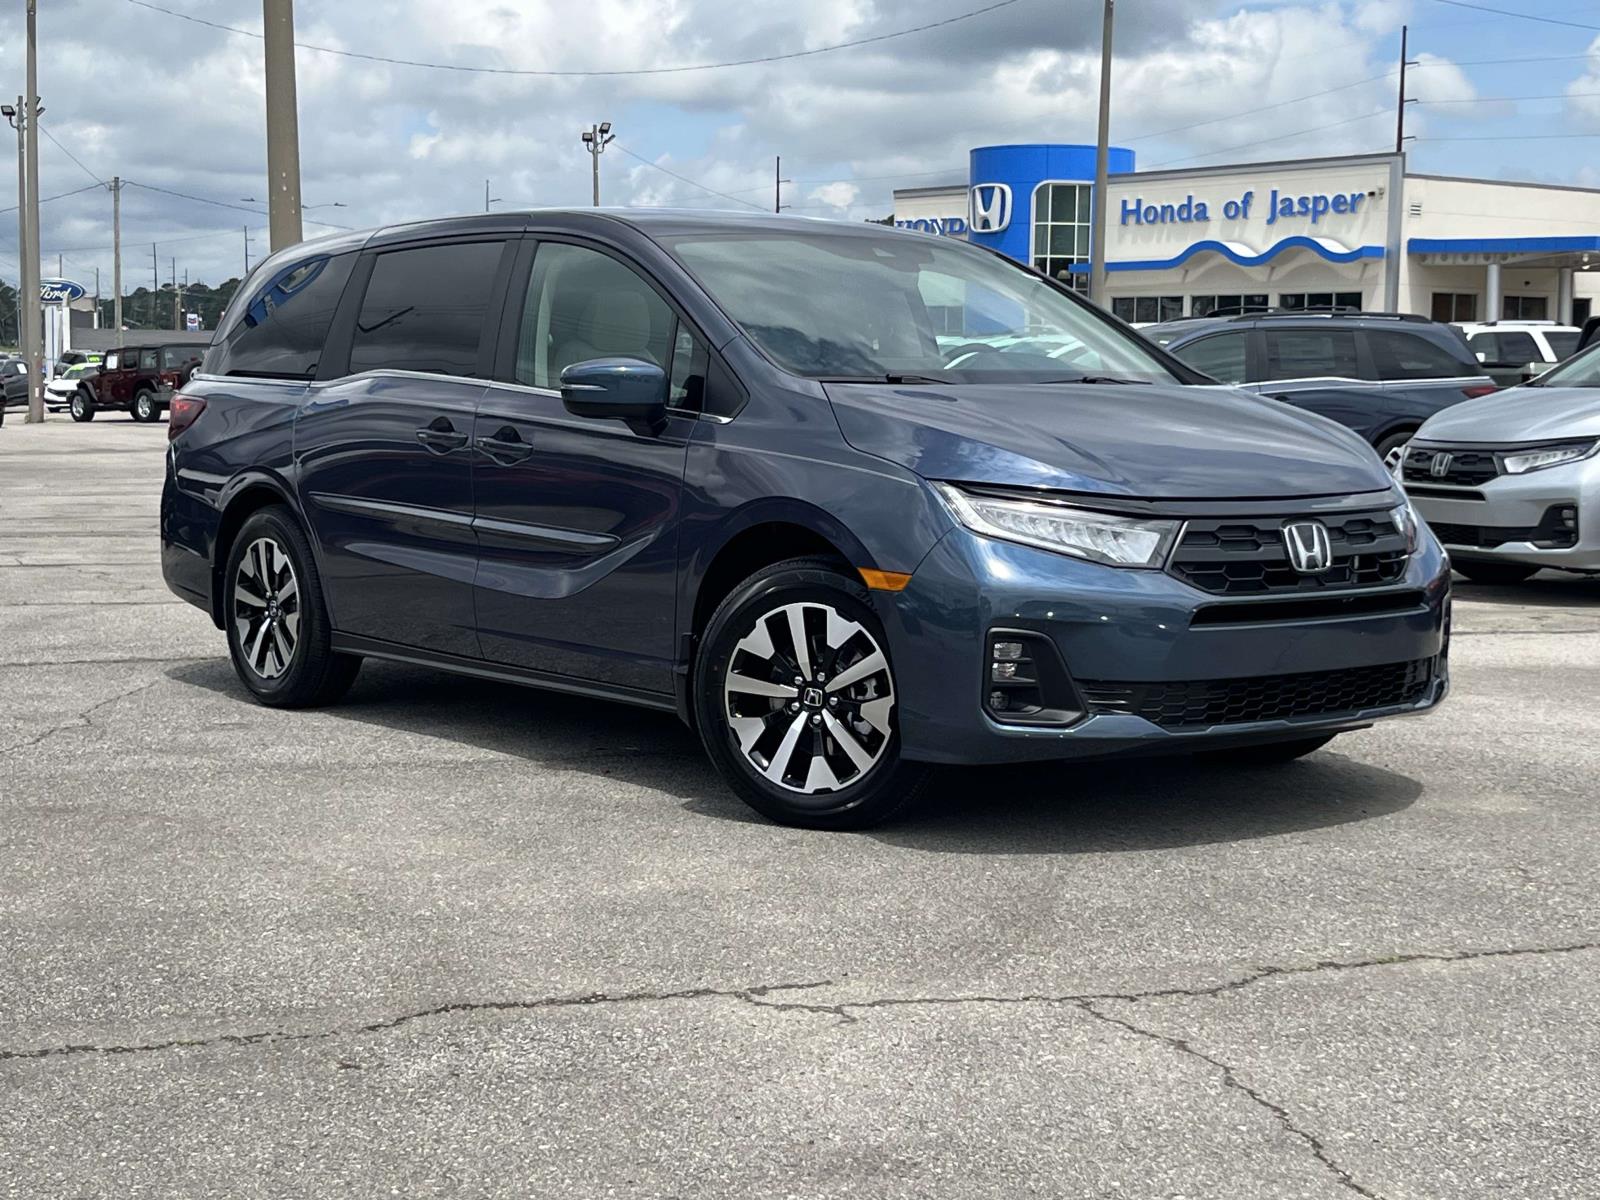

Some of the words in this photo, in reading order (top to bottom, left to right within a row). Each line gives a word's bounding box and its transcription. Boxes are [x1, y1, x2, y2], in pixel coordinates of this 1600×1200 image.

[1120, 195, 1210, 225] Honda
[1223, 191, 1254, 220] of
[1266, 190, 1366, 225] Jasper
[895, 217, 969, 235] HOND
